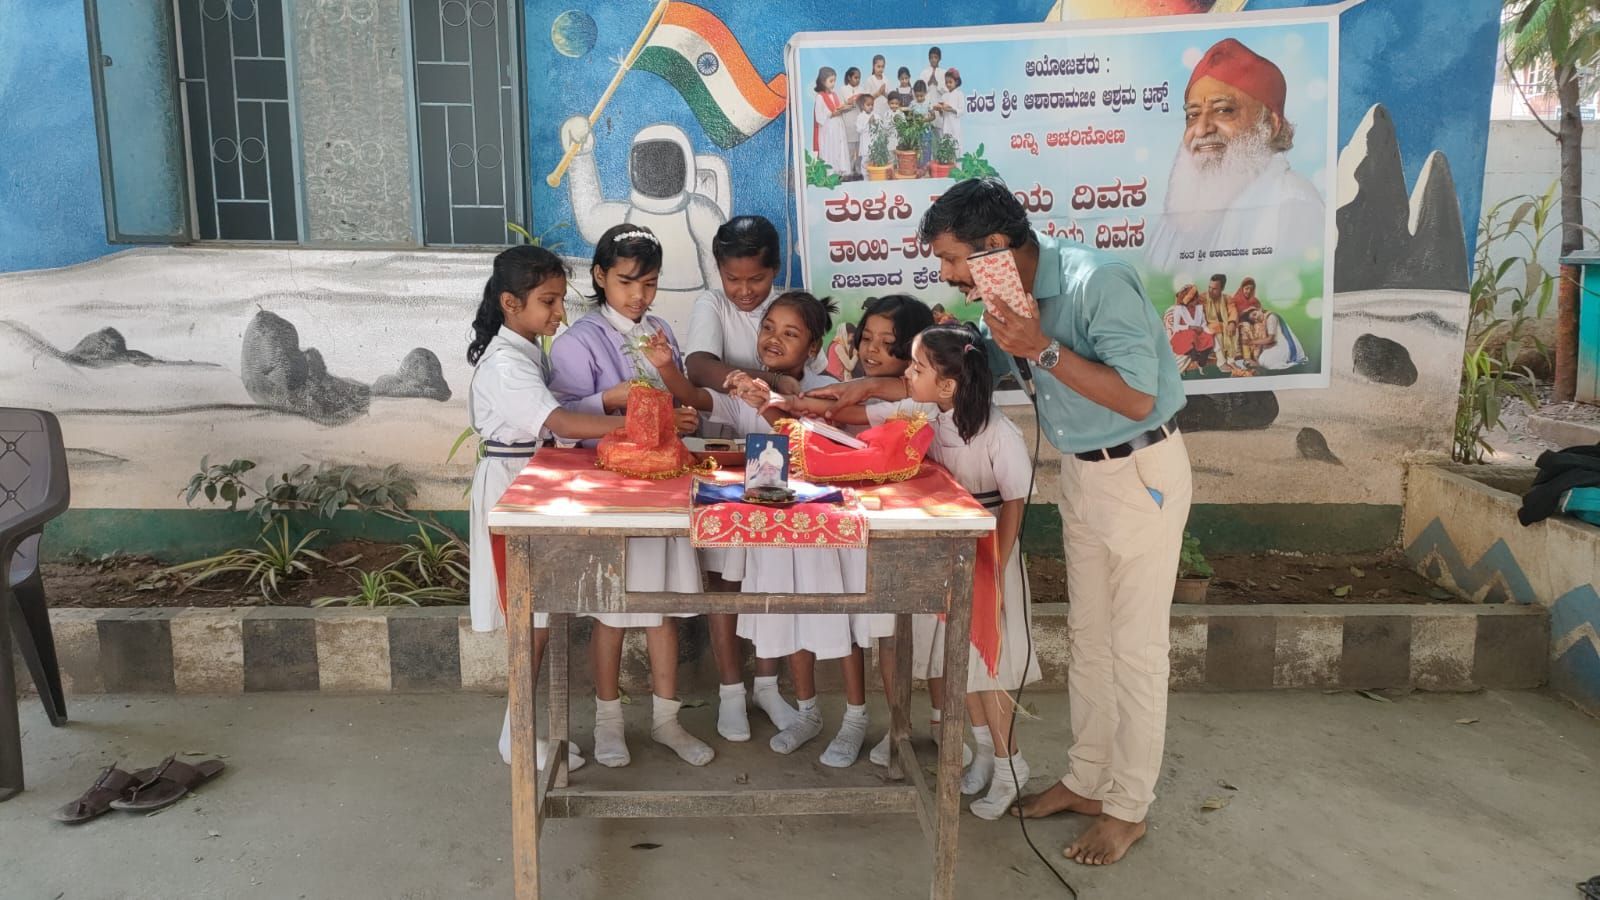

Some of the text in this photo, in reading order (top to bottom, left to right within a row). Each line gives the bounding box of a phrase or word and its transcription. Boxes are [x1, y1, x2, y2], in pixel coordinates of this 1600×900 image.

[1025, 53, 1100, 77] ಆಯೋಜಕರು
[966, 81, 1169, 118] ಸಂತ ಶ್ರೀ ಆಶಾರಾಮಜೀ ಆಶ್ರಮ ಟ್ರಸ್ಟ್
[1010, 126, 1126, 155] ಬನ್ನಿ ಆಚರಿಸೋಣ
[825, 191, 912, 222] ತುಳಸಿ
[1072, 177, 1147, 210] ದಿವಸ
[1096, 217, 1145, 248] ದಿವಸ
[832, 269, 902, 288] ನಿಜವಾದ
